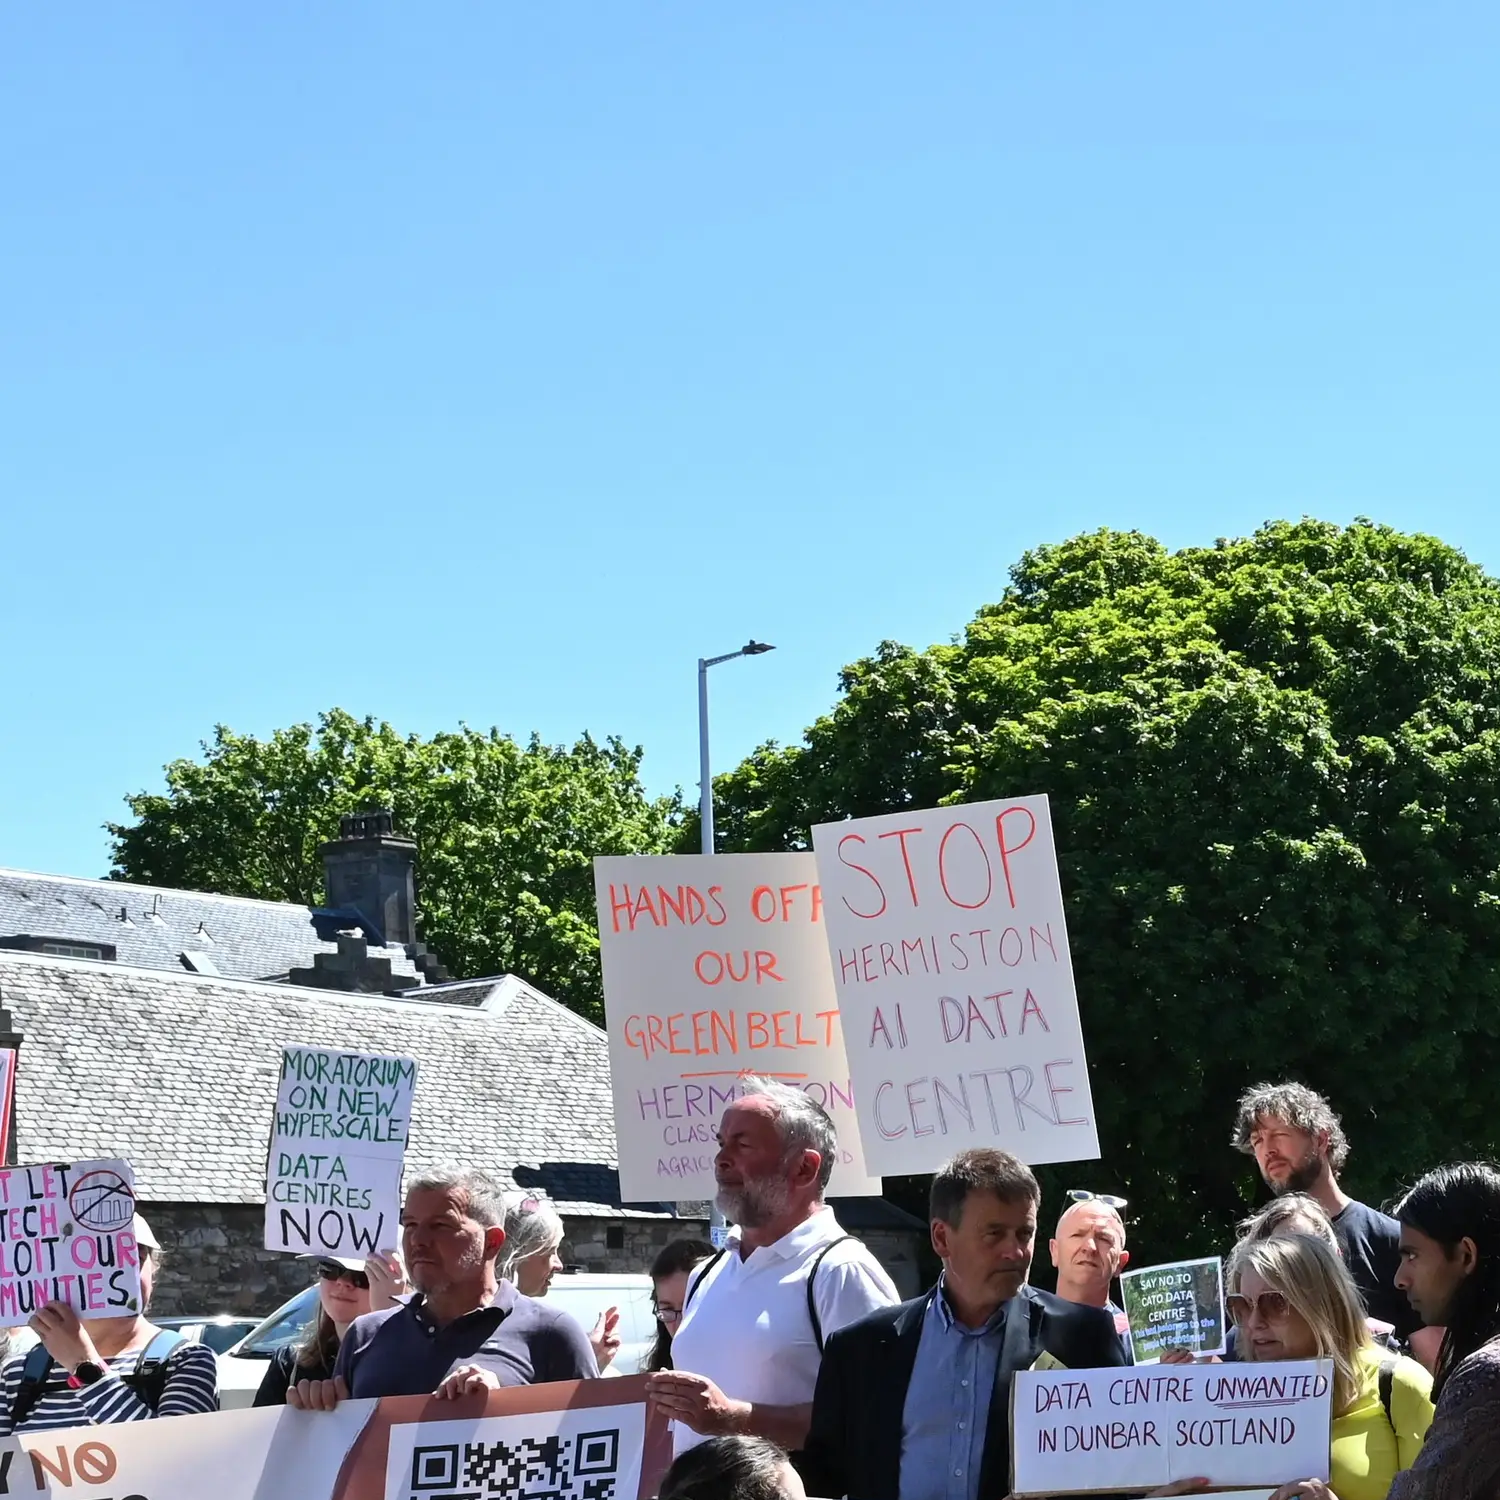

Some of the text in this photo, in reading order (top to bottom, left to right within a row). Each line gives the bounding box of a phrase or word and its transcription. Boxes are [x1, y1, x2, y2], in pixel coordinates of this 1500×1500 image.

[837, 806, 1035, 919] STOP
[608, 883, 727, 932] HANDS
[694, 949, 784, 985] OUR
[838, 922, 1058, 985] HERMISTON
[869, 988, 1051, 1049] AI DATA
[282, 1050, 414, 1090] MORATORIUM
[289, 1085, 399, 1117] ON NEW
[874, 1059, 1089, 1141] CENTRE
[277, 1112, 404, 1142] HYPERSCALE
[26, 1165, 71, 1199] LET
[278, 1152, 348, 1182] DATA
[272, 1181, 373, 1210] CENTRES
[280, 1208, 384, 1252] NOW
[0, 1232, 137, 1278] LOIT OUR
[0, 1270, 130, 1317] MUNITIES
[1140, 1273, 1191, 1290] SAY NO TO
[1141, 1290, 1194, 1307] CATO DATA
[1148, 1307, 1186, 1322] CENTRE
[1035, 1375, 1328, 1413] DATA CENTRE UNWANTED
[1038, 1417, 1295, 1453] IN DUNBAR SCOTLAND
[28, 1441, 117, 1491] NO
